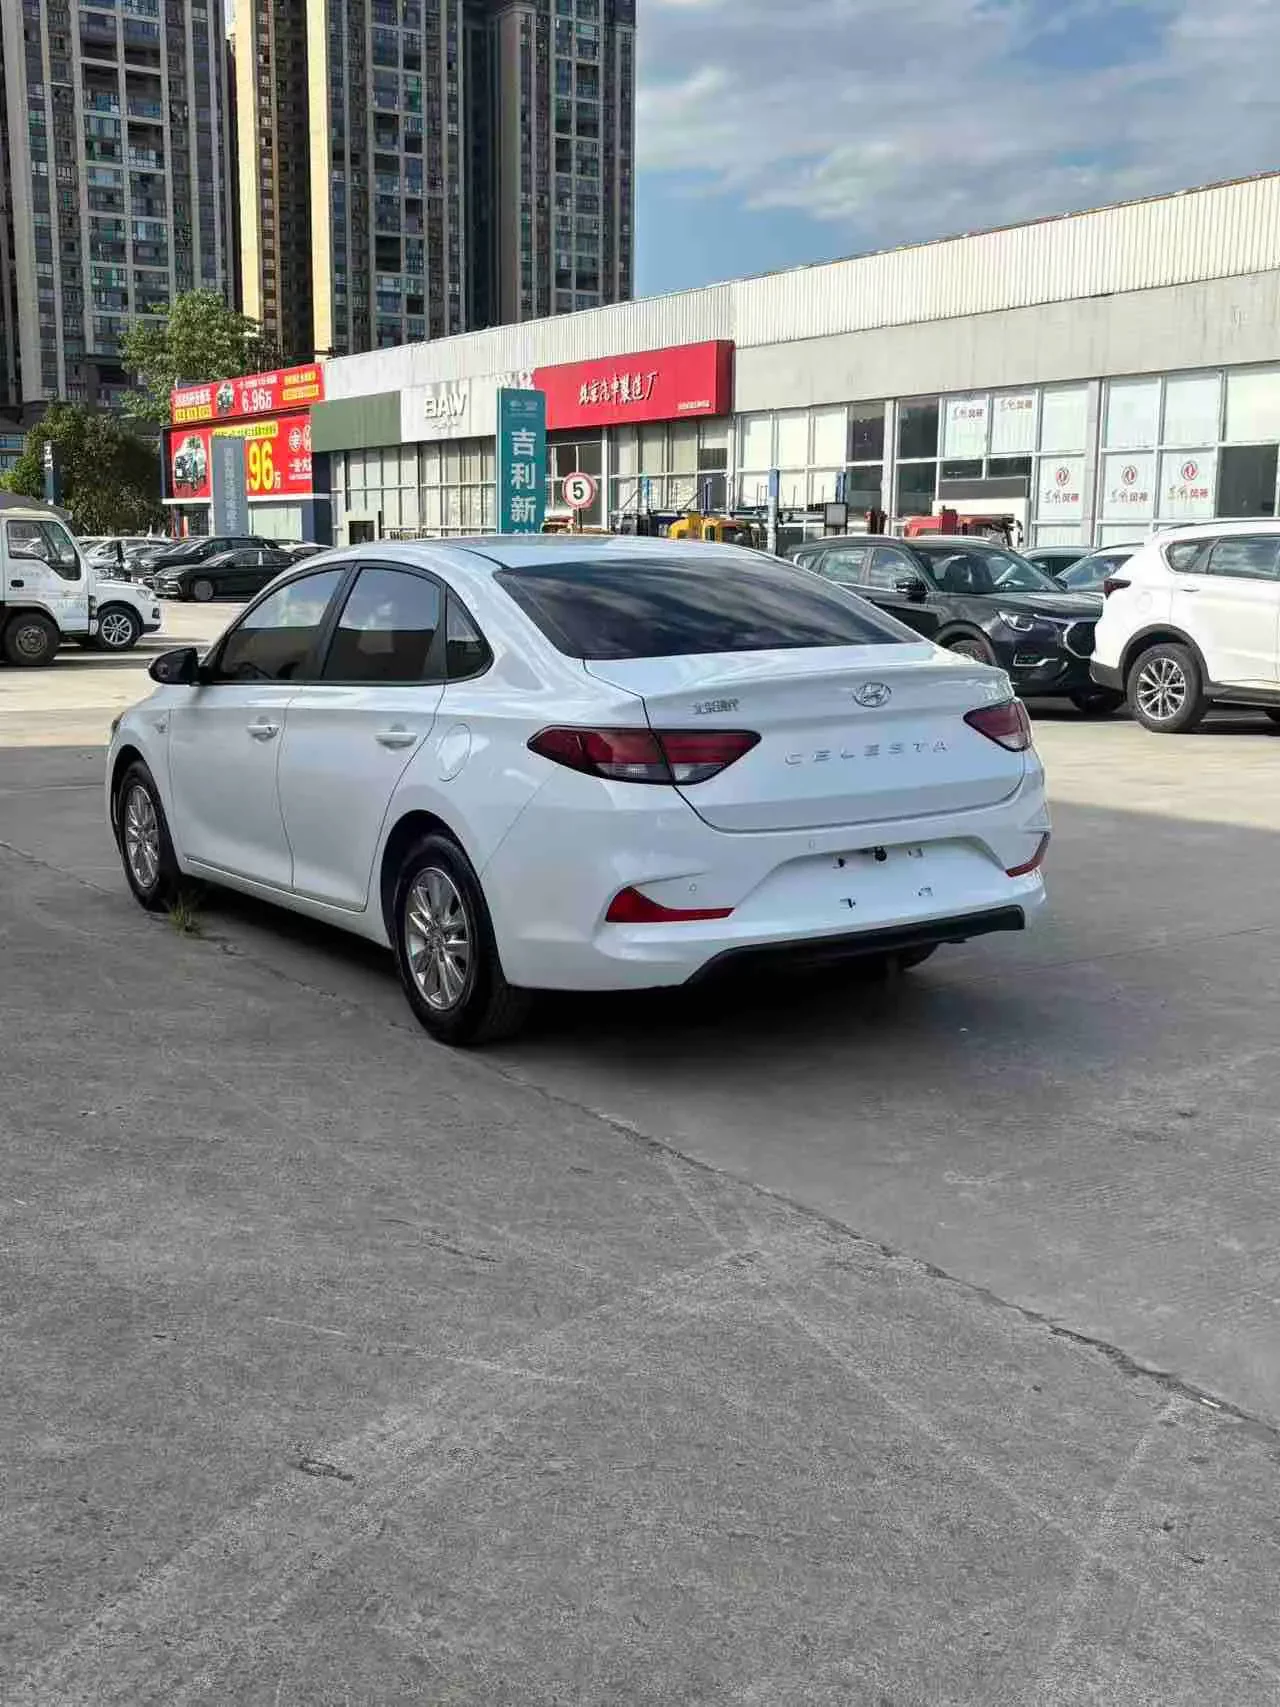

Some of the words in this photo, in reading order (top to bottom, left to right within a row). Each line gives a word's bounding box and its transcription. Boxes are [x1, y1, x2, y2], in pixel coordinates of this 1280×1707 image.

[424, 392, 467, 418] BAW
[572, 480, 584, 500] 5
[784, 741, 948, 766] CELESTA
